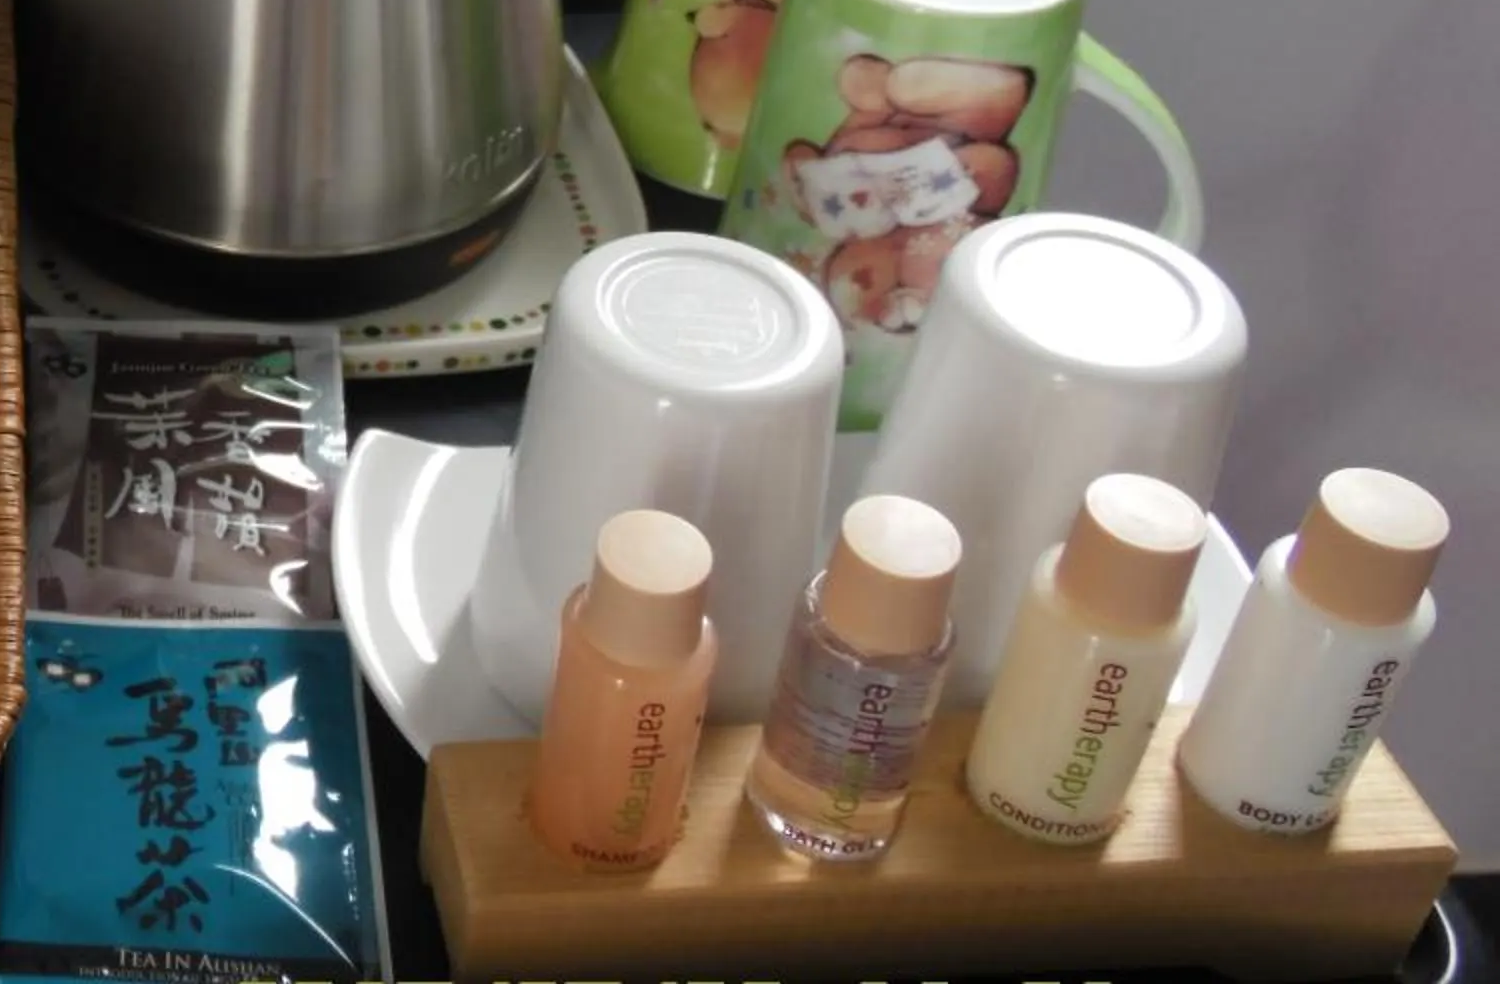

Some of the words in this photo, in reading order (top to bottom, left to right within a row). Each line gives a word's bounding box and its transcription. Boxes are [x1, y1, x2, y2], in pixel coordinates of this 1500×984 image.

[609, 701, 668, 838] eartherapy
[1046, 660, 1129, 811] eartherapy
[1307, 657, 1401, 798] eartherapy
[784, 822, 837, 855] BATH
[1238, 799, 1301, 827] BODY
